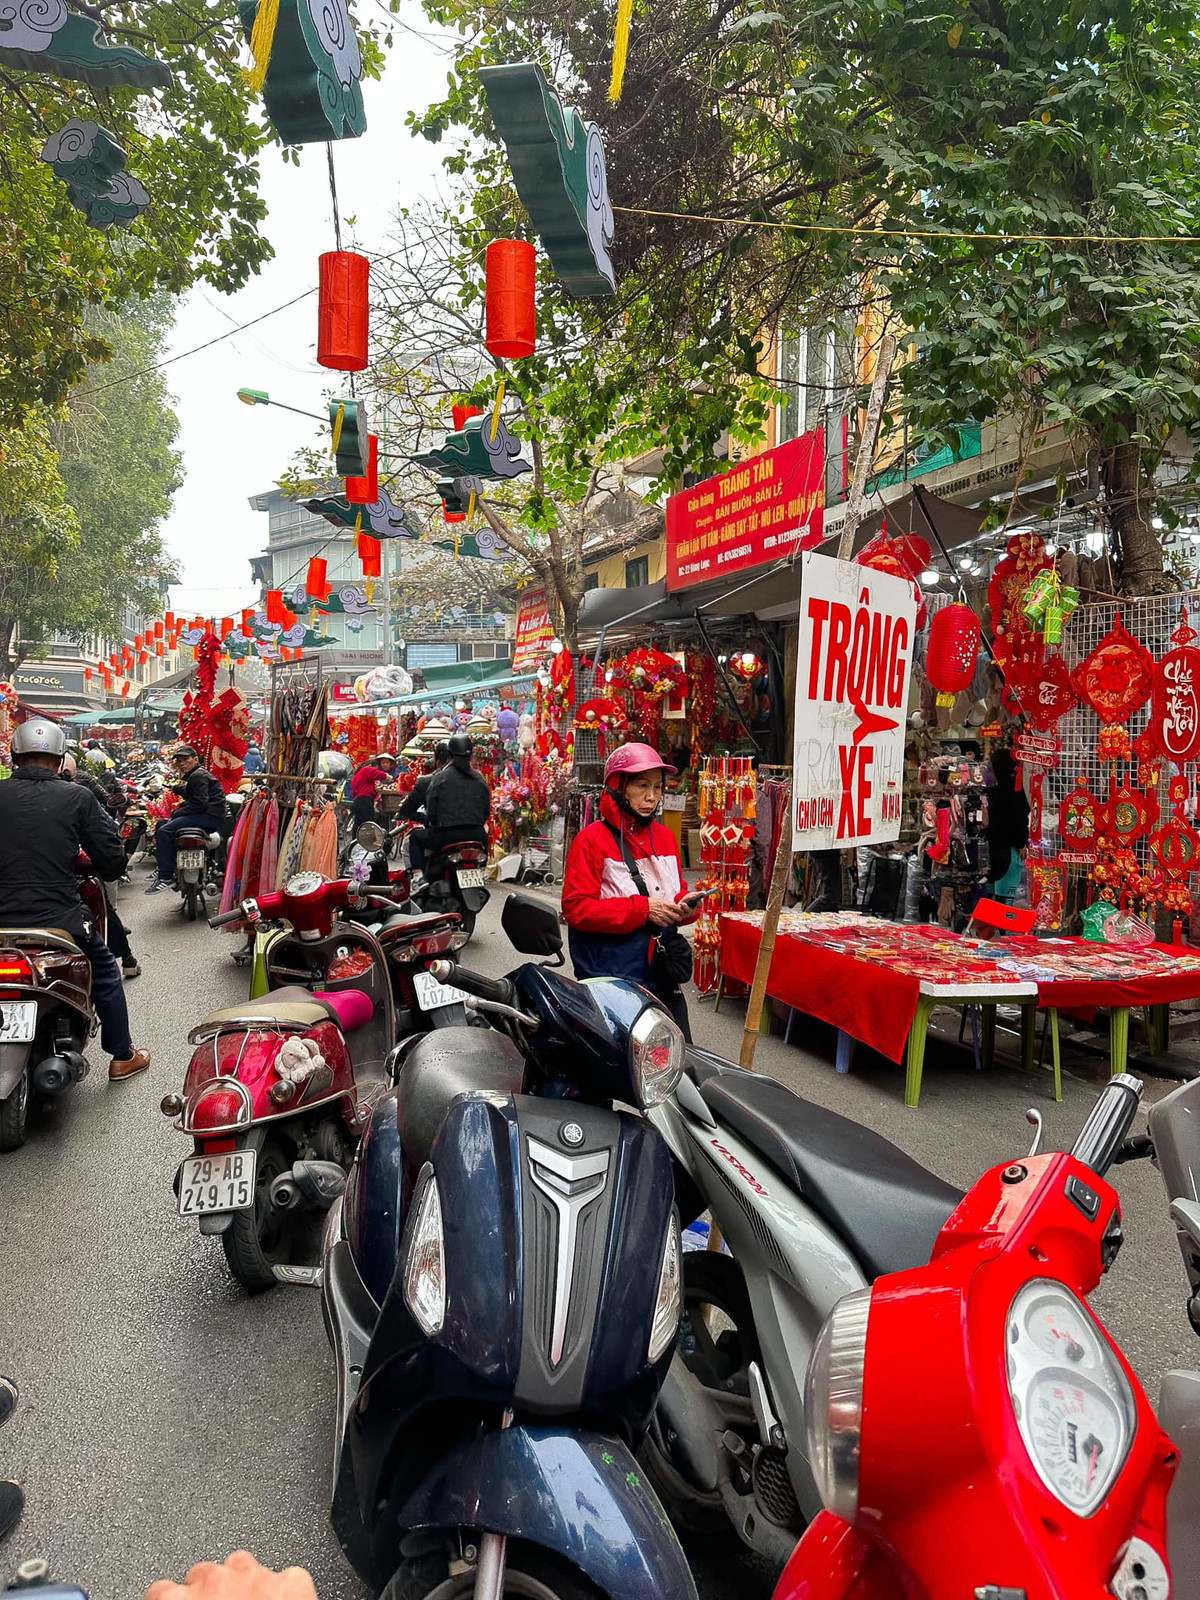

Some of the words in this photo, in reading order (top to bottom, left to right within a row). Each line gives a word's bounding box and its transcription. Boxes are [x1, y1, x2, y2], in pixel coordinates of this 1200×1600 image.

[719, 468, 750, 498] TRANG
[753, 458, 774, 482] TÂN
[715, 505, 730, 519] BÁN
[732, 495, 753, 514] BUÔN
[755, 486, 772, 503] BÁN
[772, 503, 785, 524] LEN
[807, 586, 908, 709] TRÔNG
[1038, 681, 1060, 706] Tết
[837, 745, 873, 840] XE
[191, 1156, 243, 1185] 29-AB
[183, 1180, 249, 1212] 249.15
